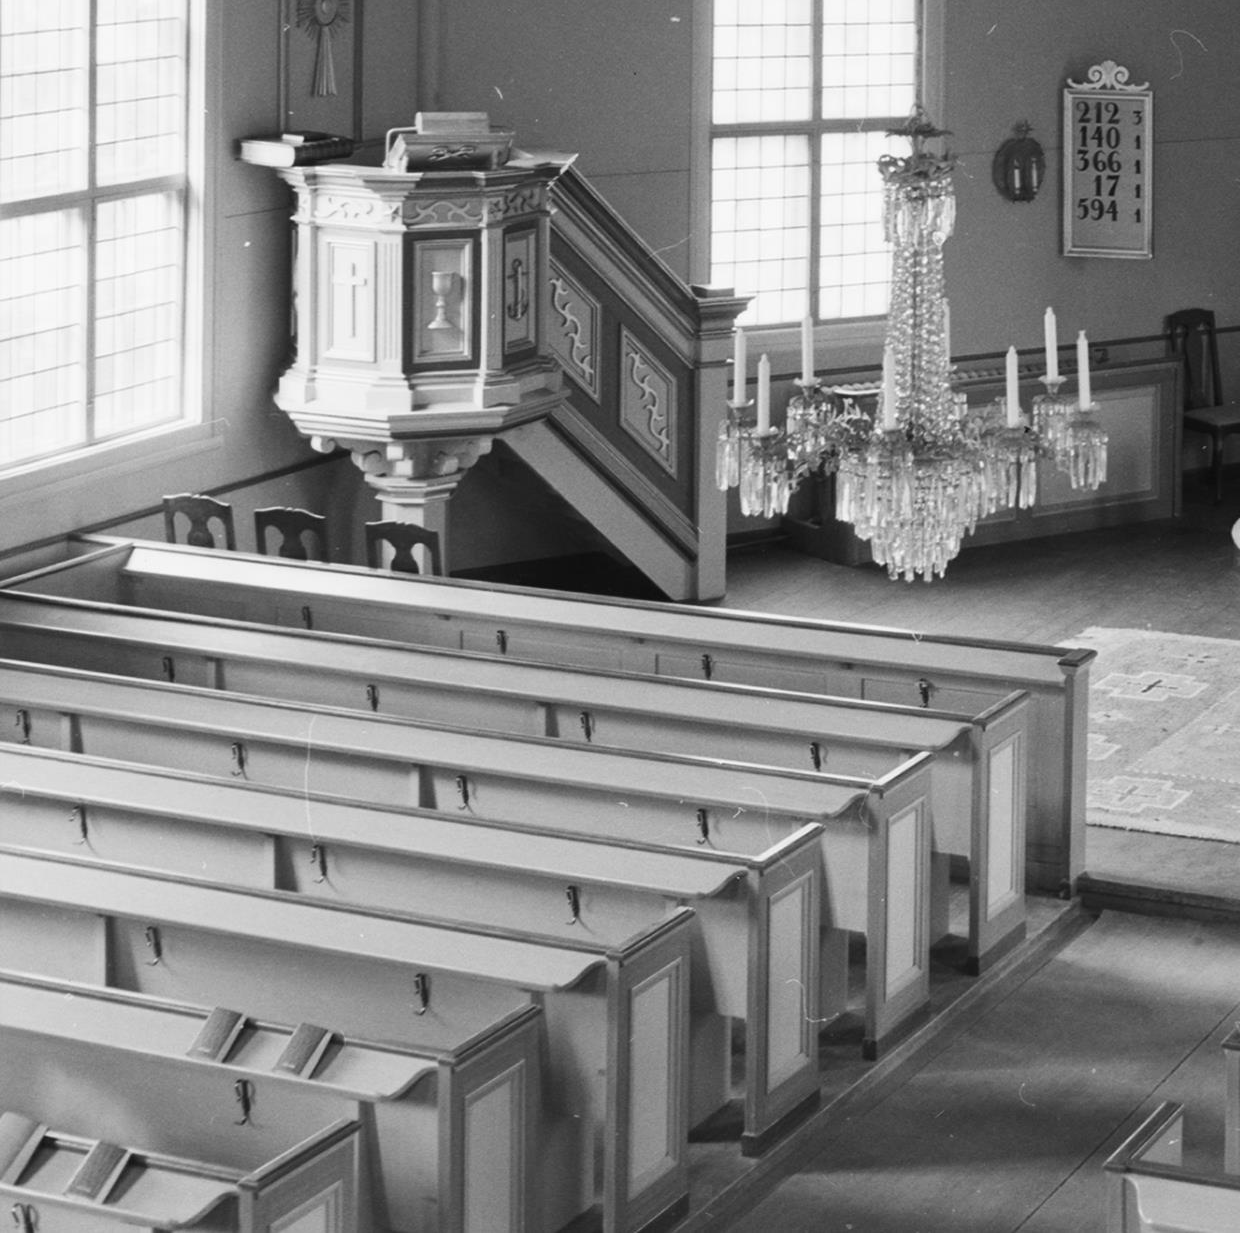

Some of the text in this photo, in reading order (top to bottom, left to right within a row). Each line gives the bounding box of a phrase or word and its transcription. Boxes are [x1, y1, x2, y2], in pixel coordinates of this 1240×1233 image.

[1076, 101, 1142, 125] 212 3
[1080, 126, 1141, 150] 140 1
[1076, 150, 1141, 174] 366 1
[1094, 175, 1141, 198] 17 1
[1077, 199, 1141, 223] 594 1
